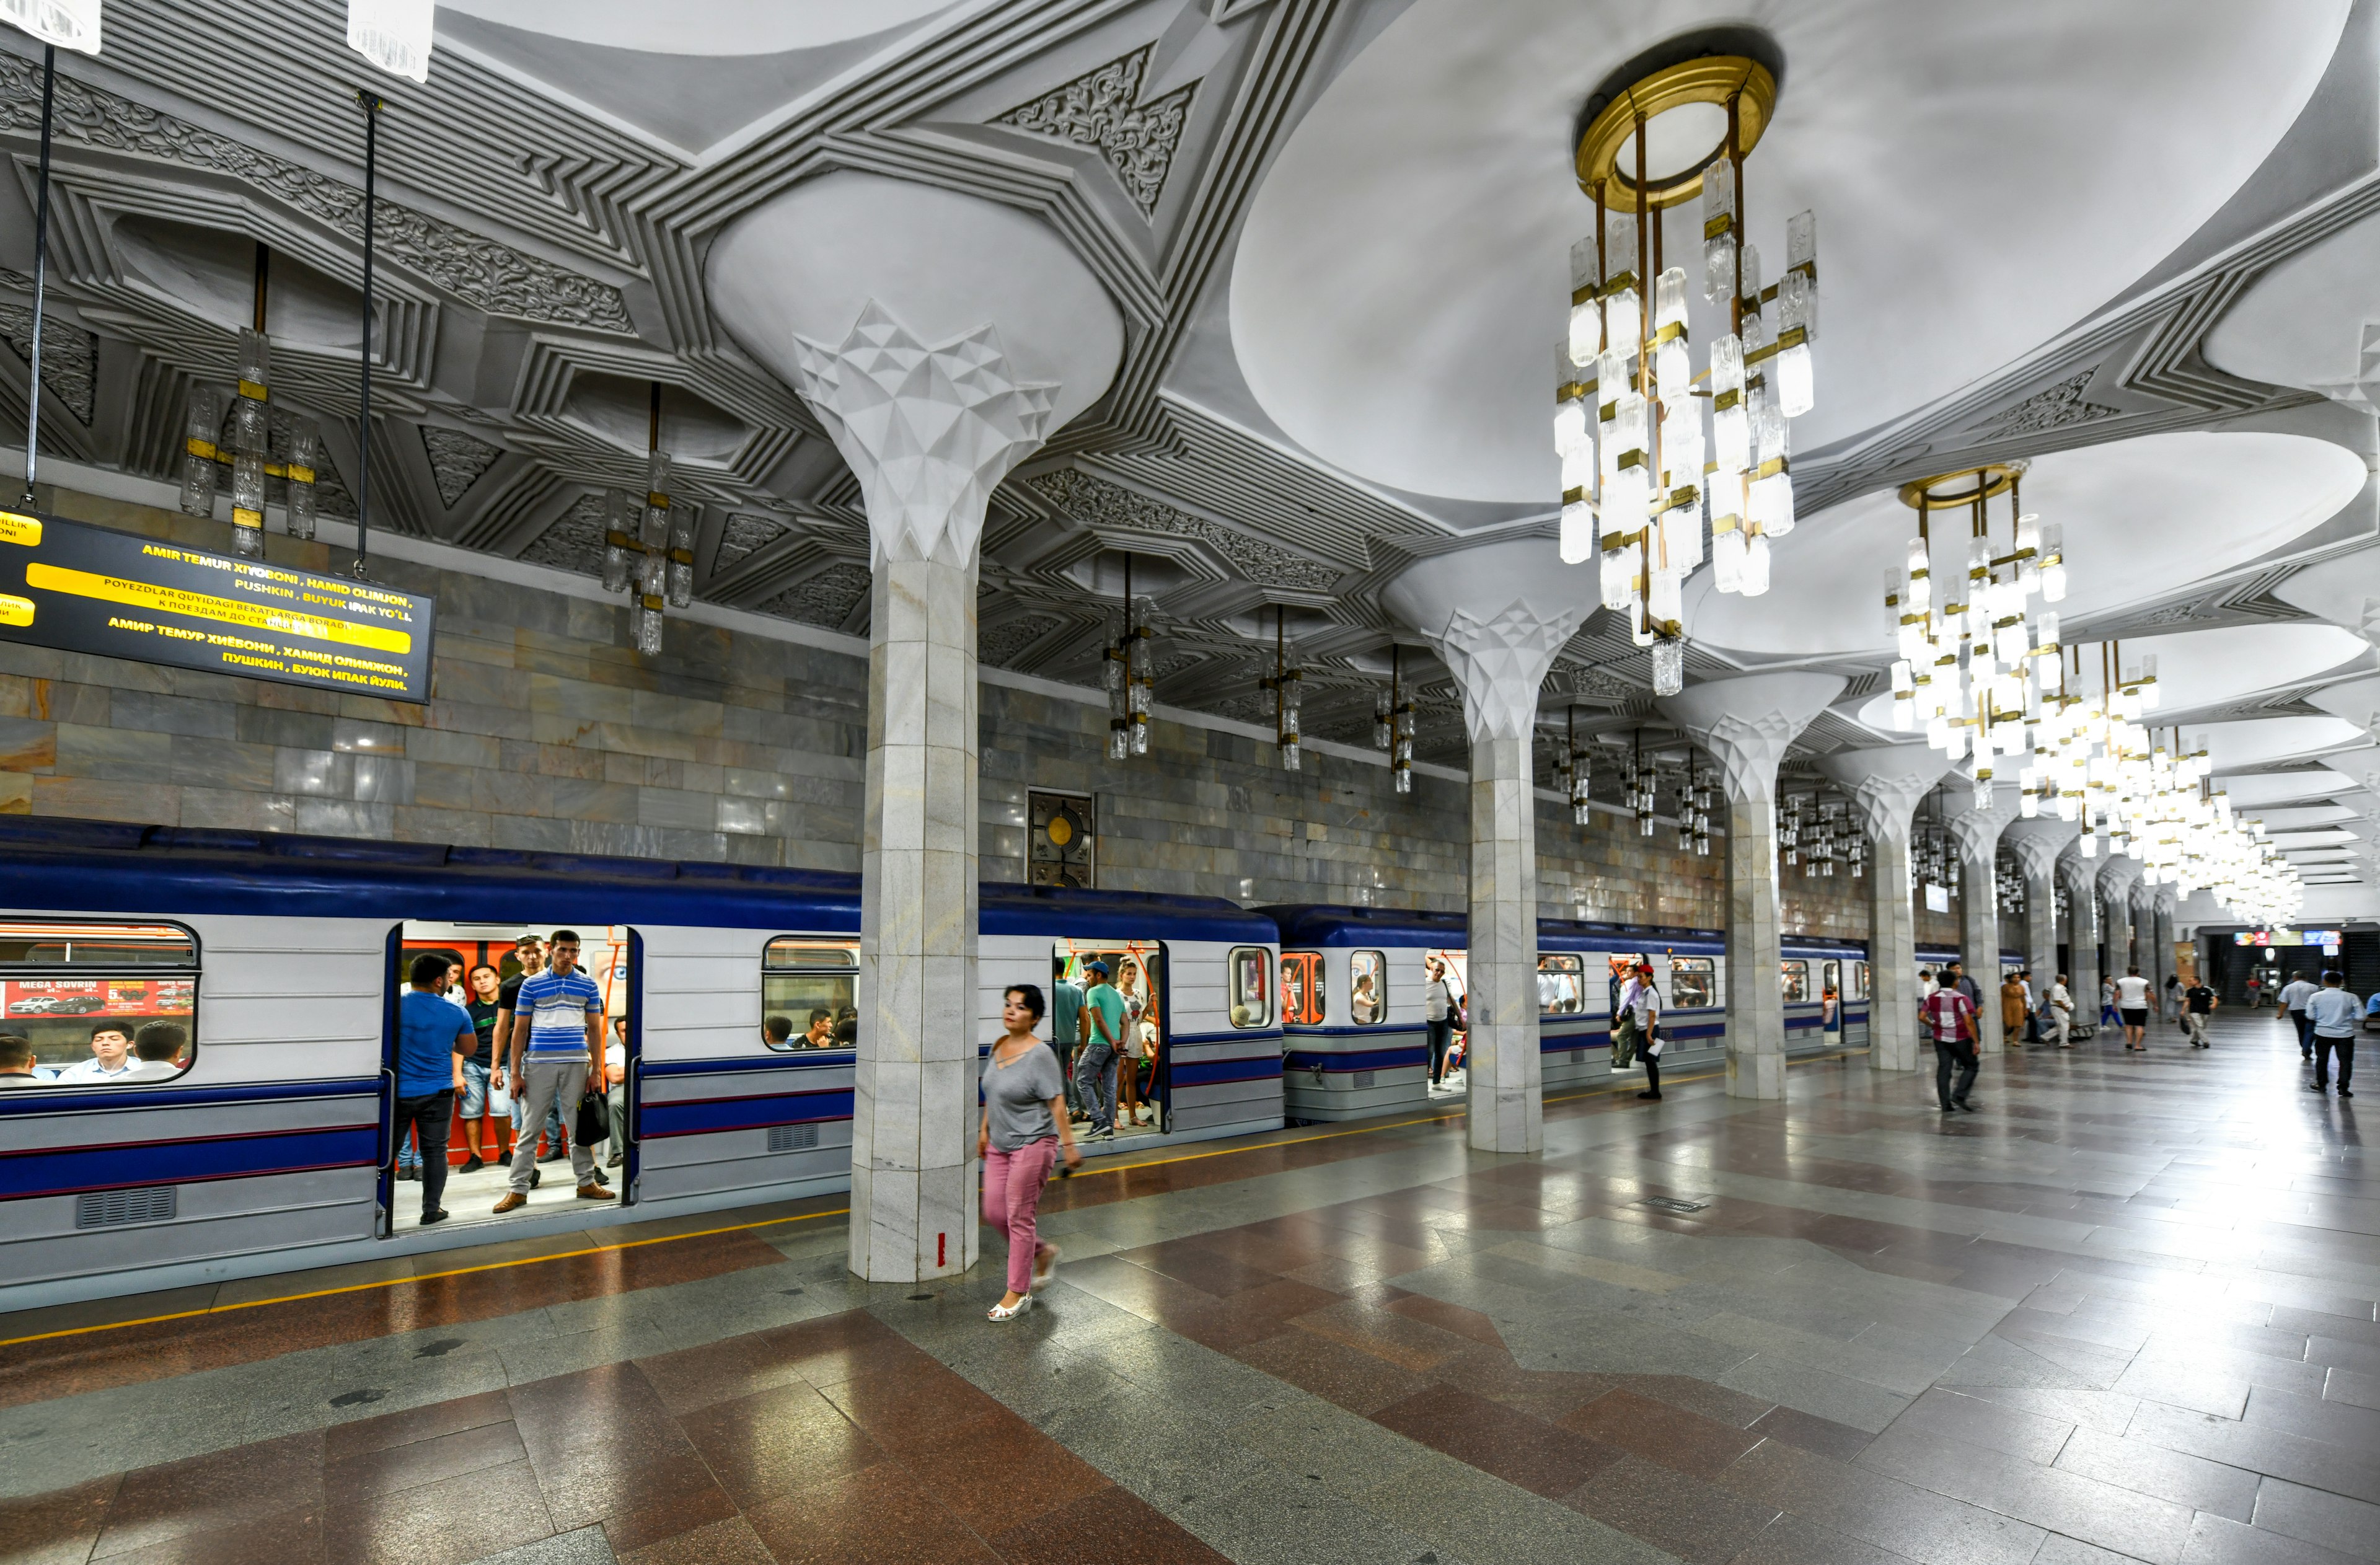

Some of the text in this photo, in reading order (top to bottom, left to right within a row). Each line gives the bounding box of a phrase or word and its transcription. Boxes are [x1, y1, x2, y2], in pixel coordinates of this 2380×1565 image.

[143, 545, 180, 561] AMIR
[182, 552, 231, 571] TEMUR
[307, 578, 350, 595] HAMID
[104, 578, 347, 630] POYEZDLAR QUYIDAGI BEKATLARGA BORADI
[159, 599, 166, 607] К
[169, 601, 226, 617] ПОЕЗДАМ
[229, 613, 245, 621] ДО
[302, 593, 347, 609] BUYUK
[348, 601, 377, 615] IPAK
[108, 617, 154, 633] АМИР
[156, 625, 205, 641] ТЕМУР
[283, 646, 332, 665] ХАМИД
[292, 663, 330, 679] БУЮК
[332, 670, 368, 684] ИПАК
